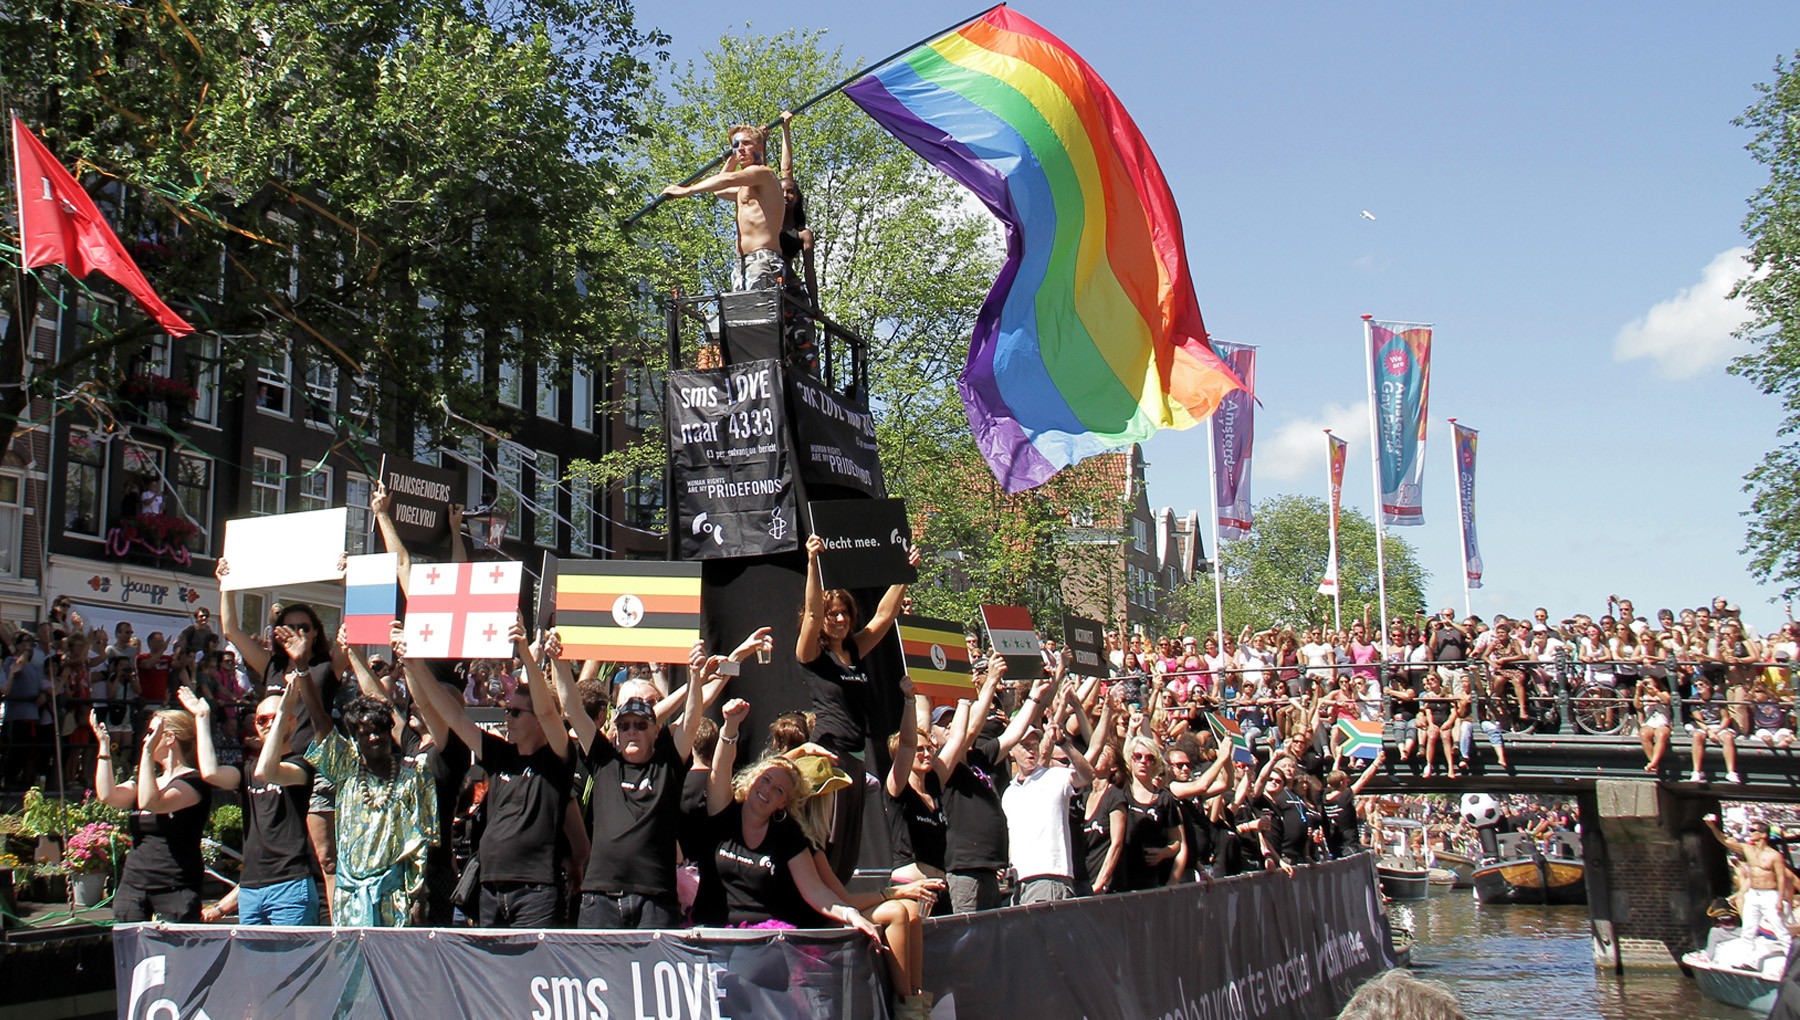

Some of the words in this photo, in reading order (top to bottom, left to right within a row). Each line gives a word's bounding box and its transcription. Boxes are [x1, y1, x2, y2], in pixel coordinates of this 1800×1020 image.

[1389, 355, 1403, 363] We
[1392, 361, 1404, 369] are
[681, 386, 718, 409] sms
[725, 369, 771, 406] LOVE
[681, 421, 719, 444] naar
[729, 408, 774, 439] 4333
[389, 472, 451, 502] TRANSGENDERS
[708, 478, 783, 499] PRIDEFONDS
[395, 503, 437, 528] VOGELVRIJ
[822, 536, 852, 550] Vecht
[854, 538, 881, 548] mee.
[530, 975, 610, 1020] sms
[631, 961, 732, 1020] LOVE
